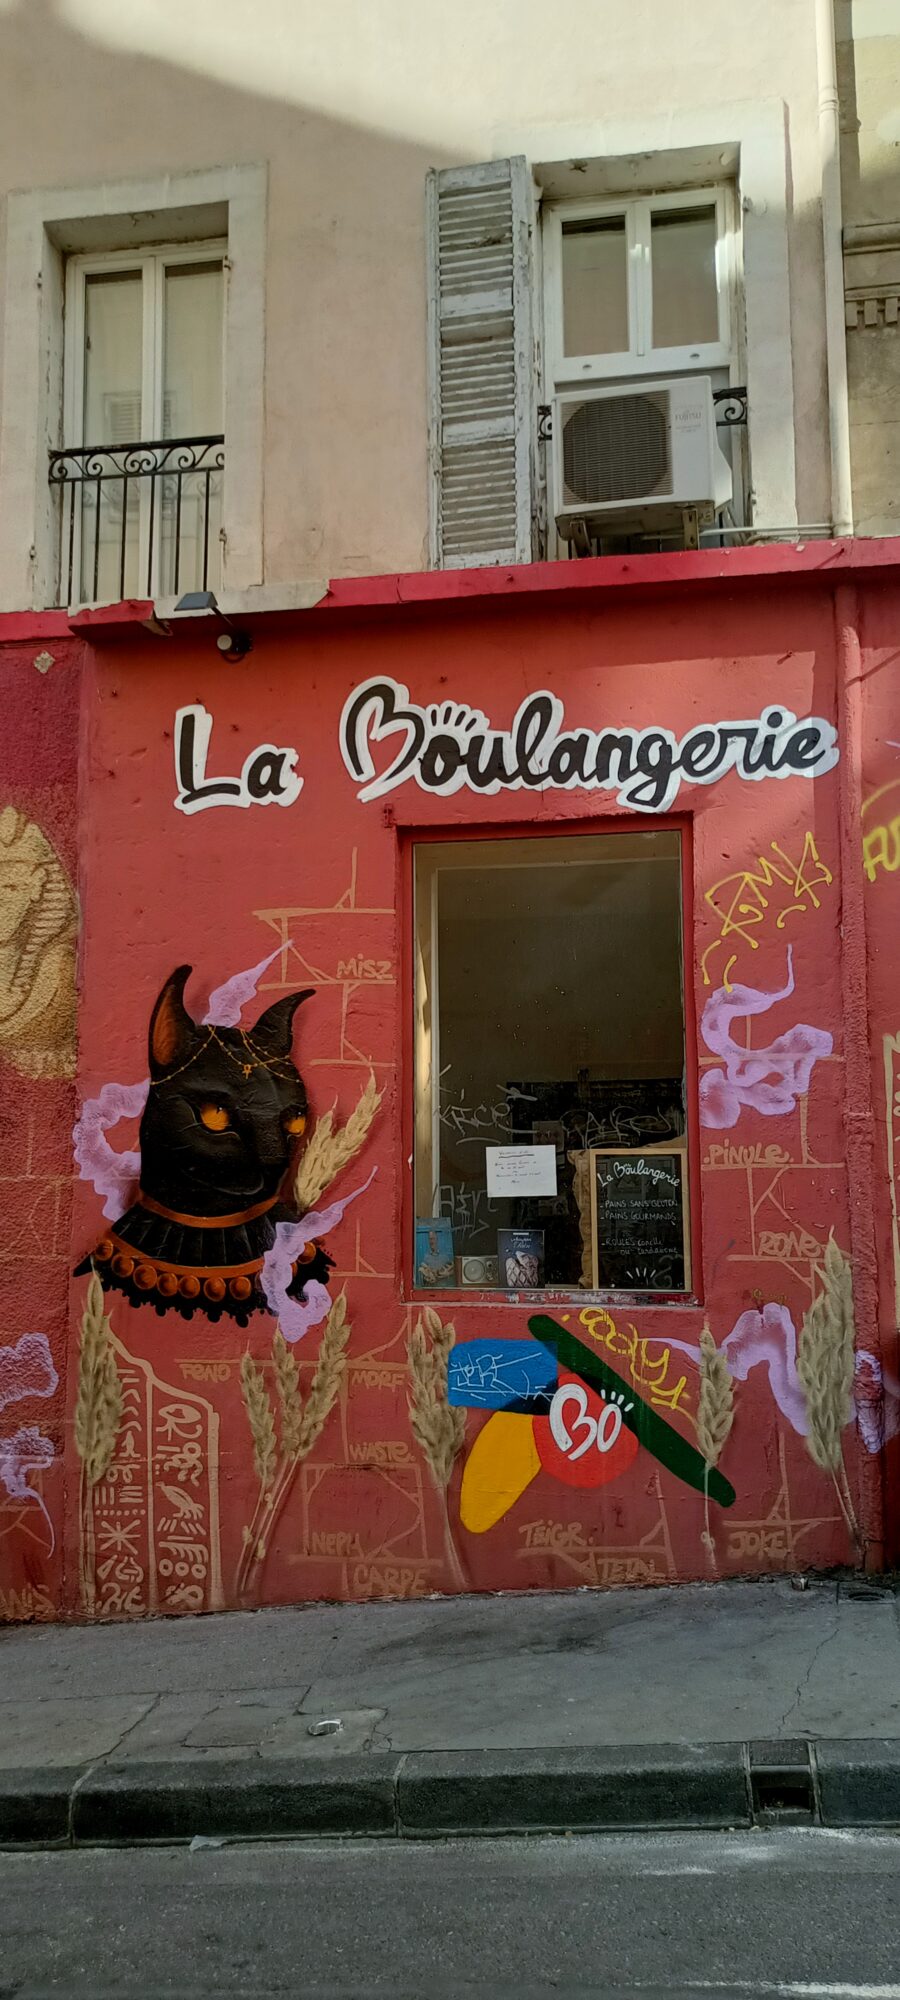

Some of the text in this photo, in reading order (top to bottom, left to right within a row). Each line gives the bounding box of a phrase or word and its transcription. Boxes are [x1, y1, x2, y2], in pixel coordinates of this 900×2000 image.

[177, 679, 834, 811] La Boulangerie
[597, 1159, 680, 1188] La Boulangerie
[629, 1199, 650, 1208] SANS
